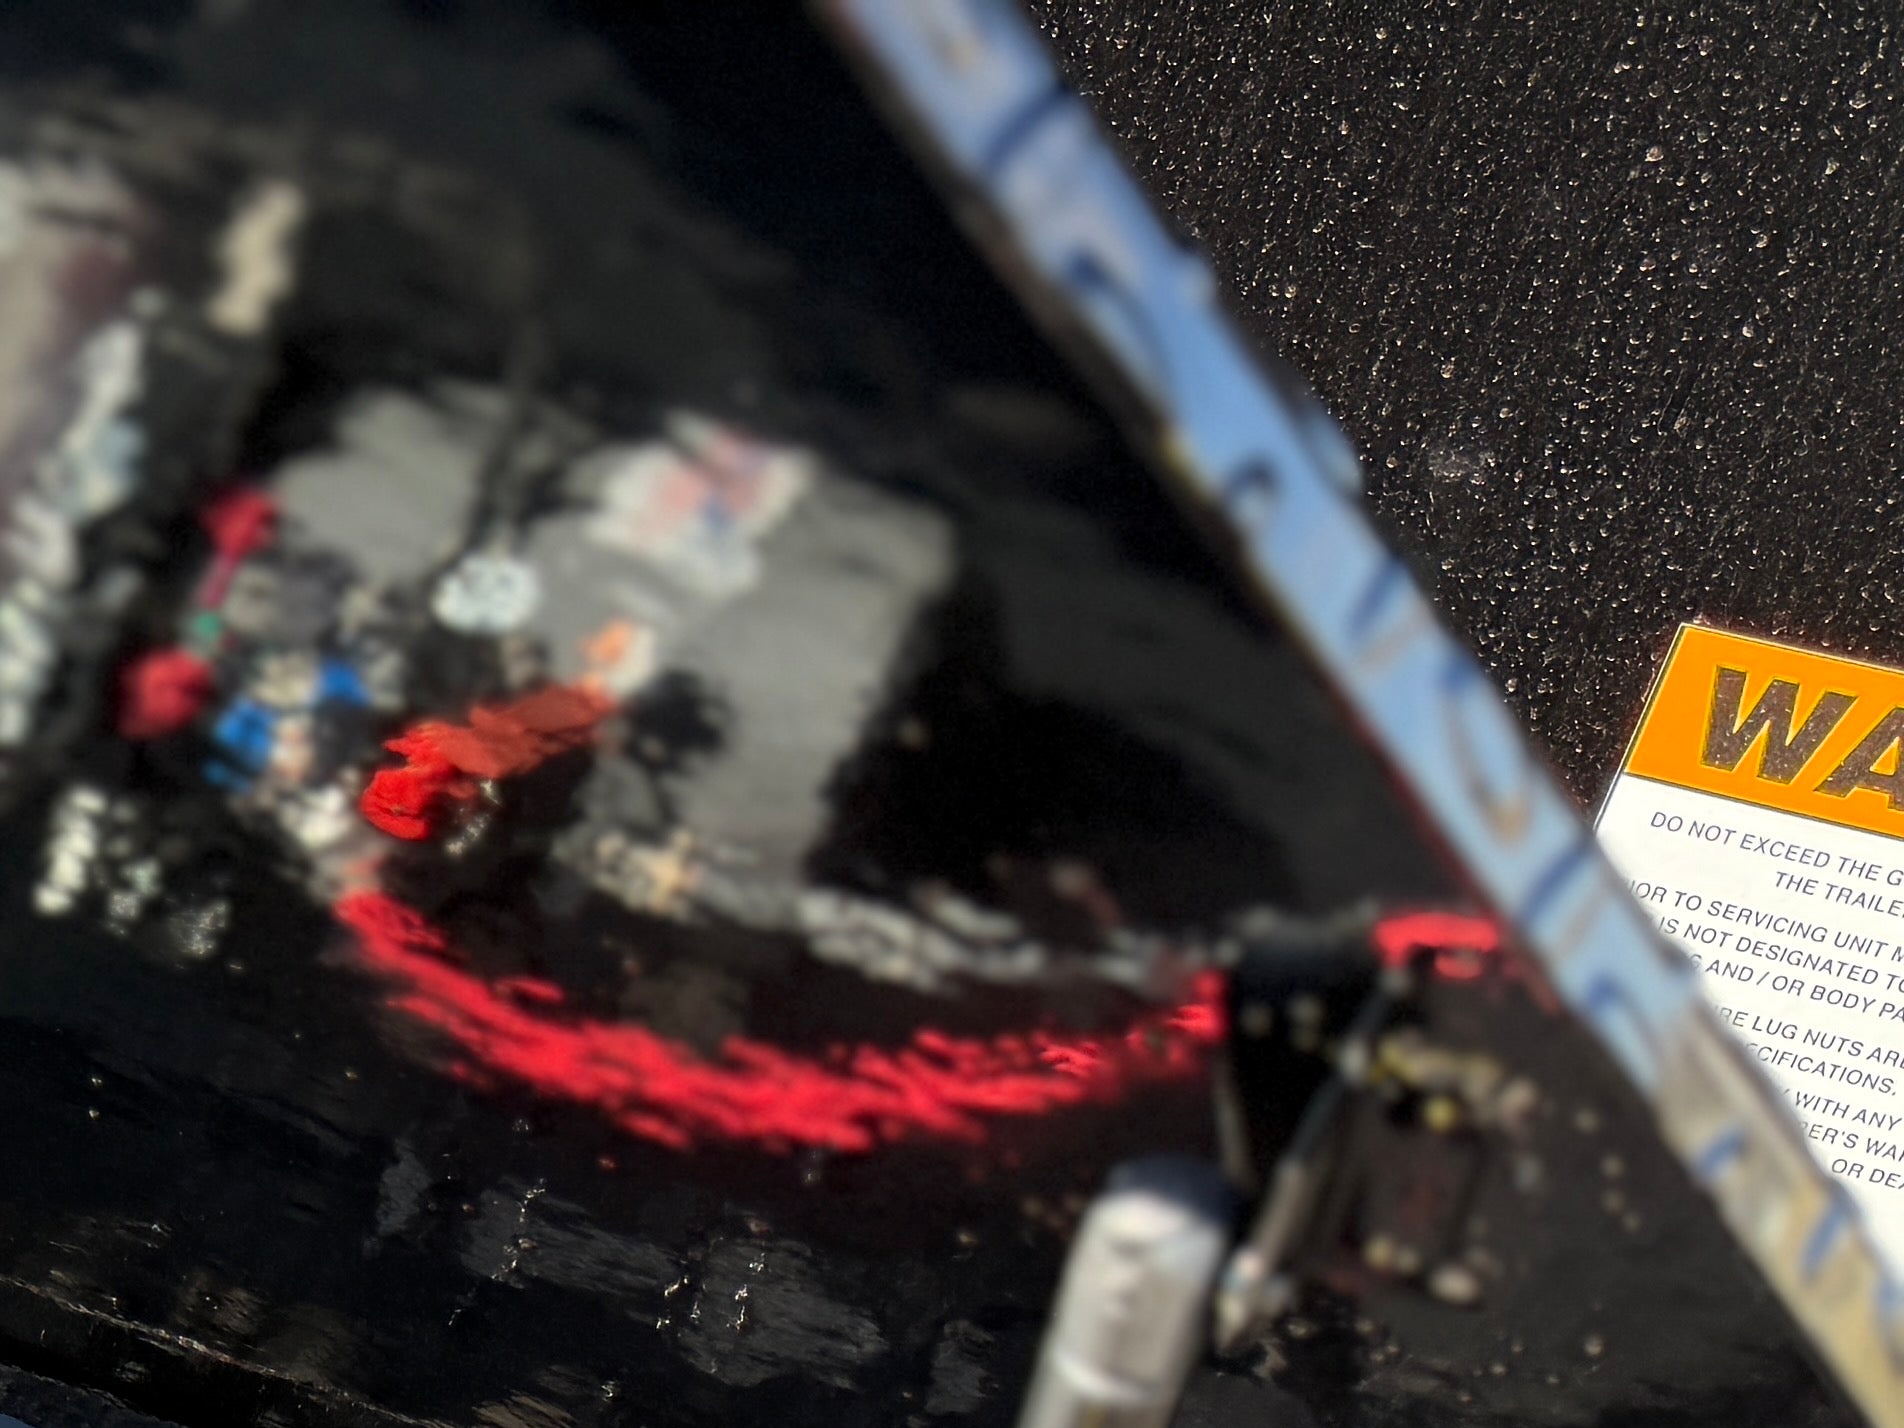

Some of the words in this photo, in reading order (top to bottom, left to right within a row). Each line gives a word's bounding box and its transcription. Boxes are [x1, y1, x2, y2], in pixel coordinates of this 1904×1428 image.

[1651, 811, 1683, 832] DO
[1688, 821, 1736, 845] NOT
[1740, 834, 1830, 867] EXCEED
[1838, 856, 1882, 881] THE
[1776, 872, 1818, 895] THE
[1825, 883, 1904, 918] TRAILE
[1675, 891, 1701, 910] TO
[1708, 901, 1827, 942] SERVICING
[1834, 931, 1888, 958] UNIT
[1684, 924, 1732, 948] NOT
[1736, 937, 1879, 985] DESIGNATED
[1706, 960, 1754, 982] AND
[1772, 976, 1805, 996] OR
[1810, 986, 1877, 1010] BODY
[1752, 1016, 1797, 1039] LUG
[1803, 1029, 1864, 1056] NUTS
[1795, 1092, 1850, 1119] WITH
[1853, 1109, 1902, 1131] ANY
[1831, 1159, 1864, 1178] OR
